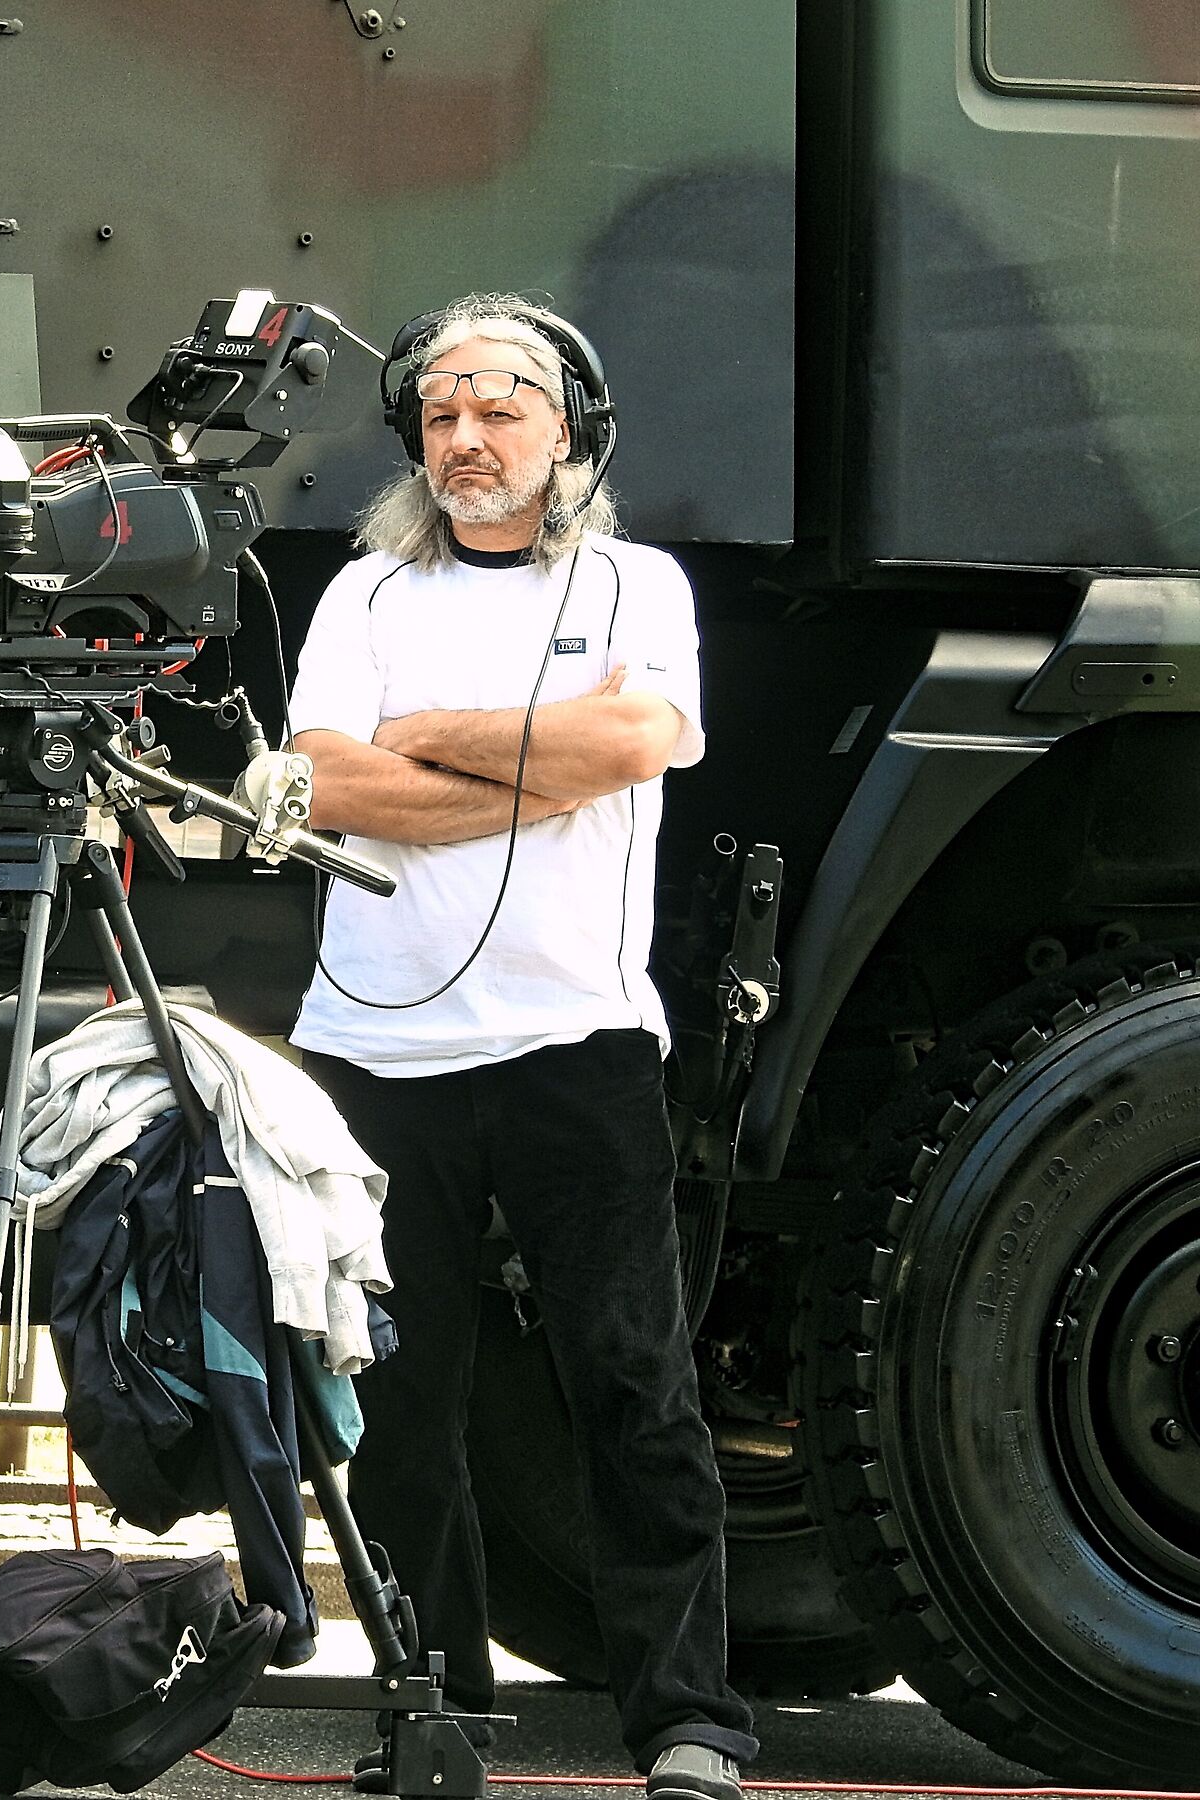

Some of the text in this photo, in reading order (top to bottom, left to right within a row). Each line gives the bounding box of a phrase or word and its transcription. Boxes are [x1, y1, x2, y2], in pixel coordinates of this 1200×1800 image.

[215, 342, 255, 356] SONY
[258, 306, 289, 349] 4
[98, 500, 134, 545] 4
[976, 1201, 1036, 1321] 12.00
[1039, 1156, 1073, 1188] R
[1088, 1100, 1136, 1148] 20
